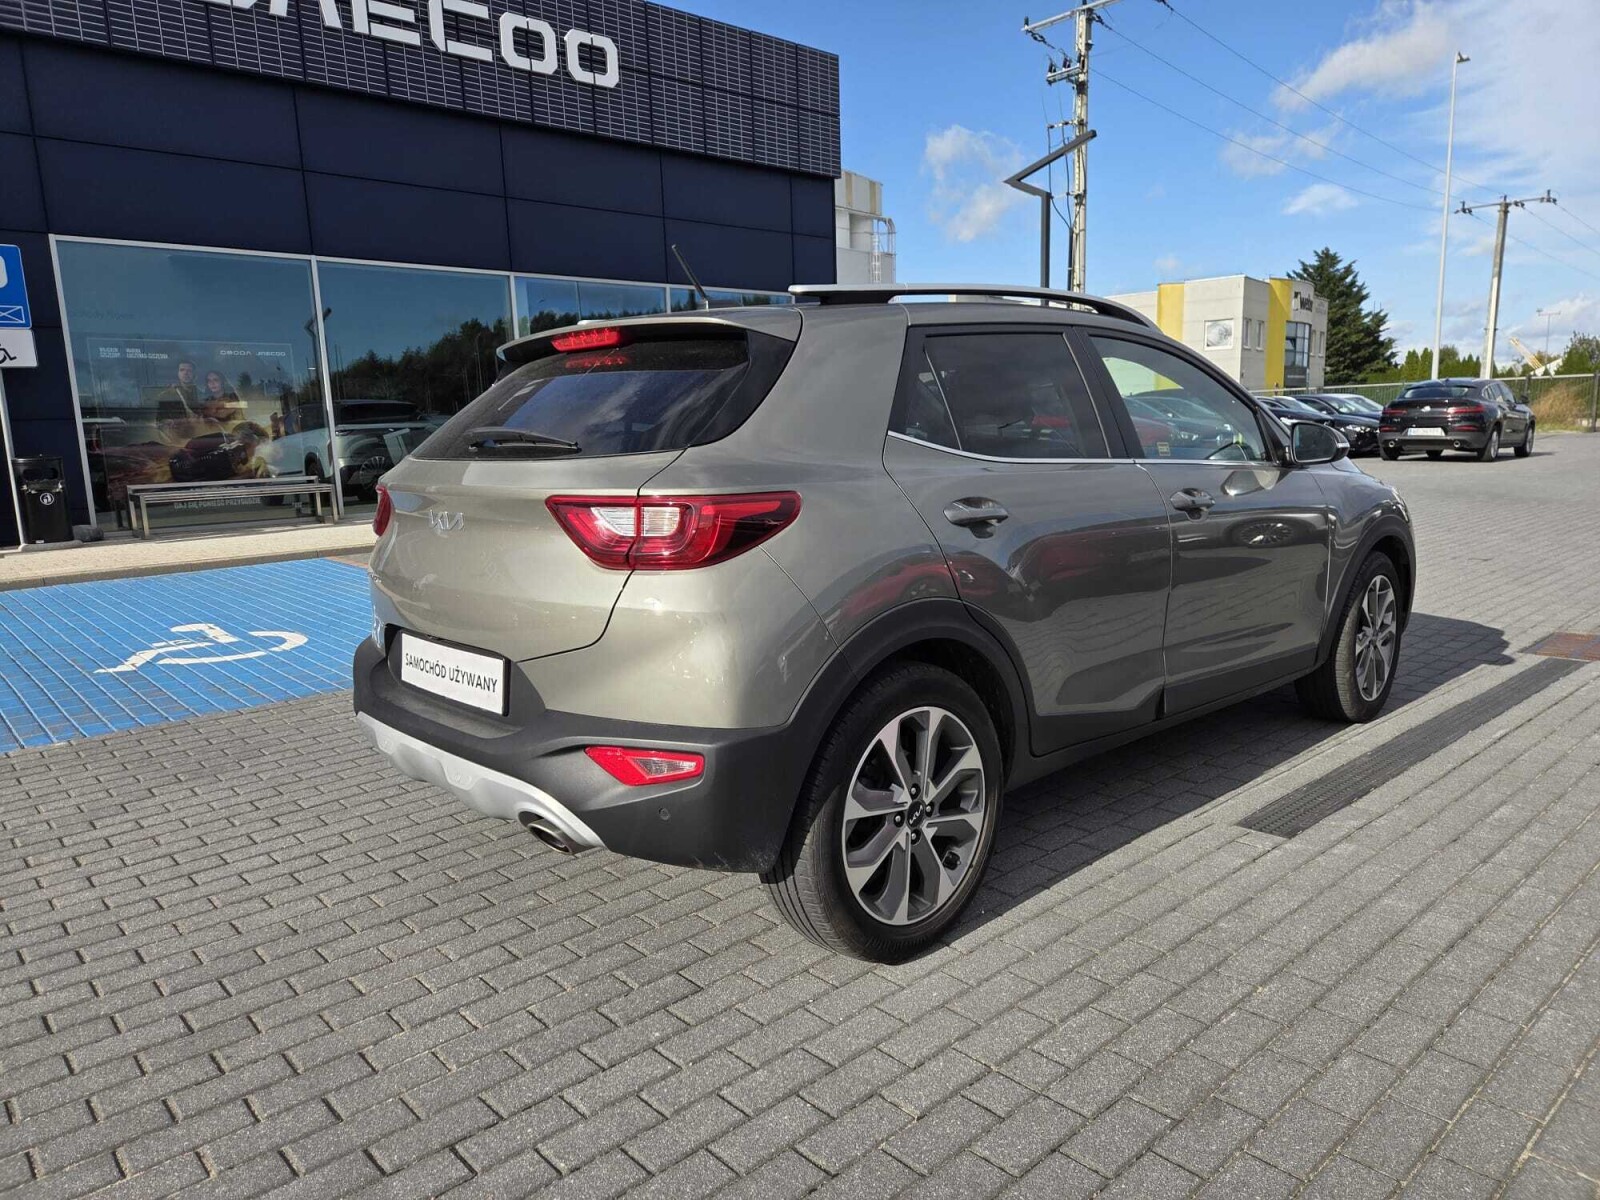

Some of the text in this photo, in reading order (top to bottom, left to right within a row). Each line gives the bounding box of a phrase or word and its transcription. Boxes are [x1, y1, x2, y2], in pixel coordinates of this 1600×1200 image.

[429, 509, 465, 531] KIA
[405, 652, 498, 693] SAMOCHÓD UŻYWANY
